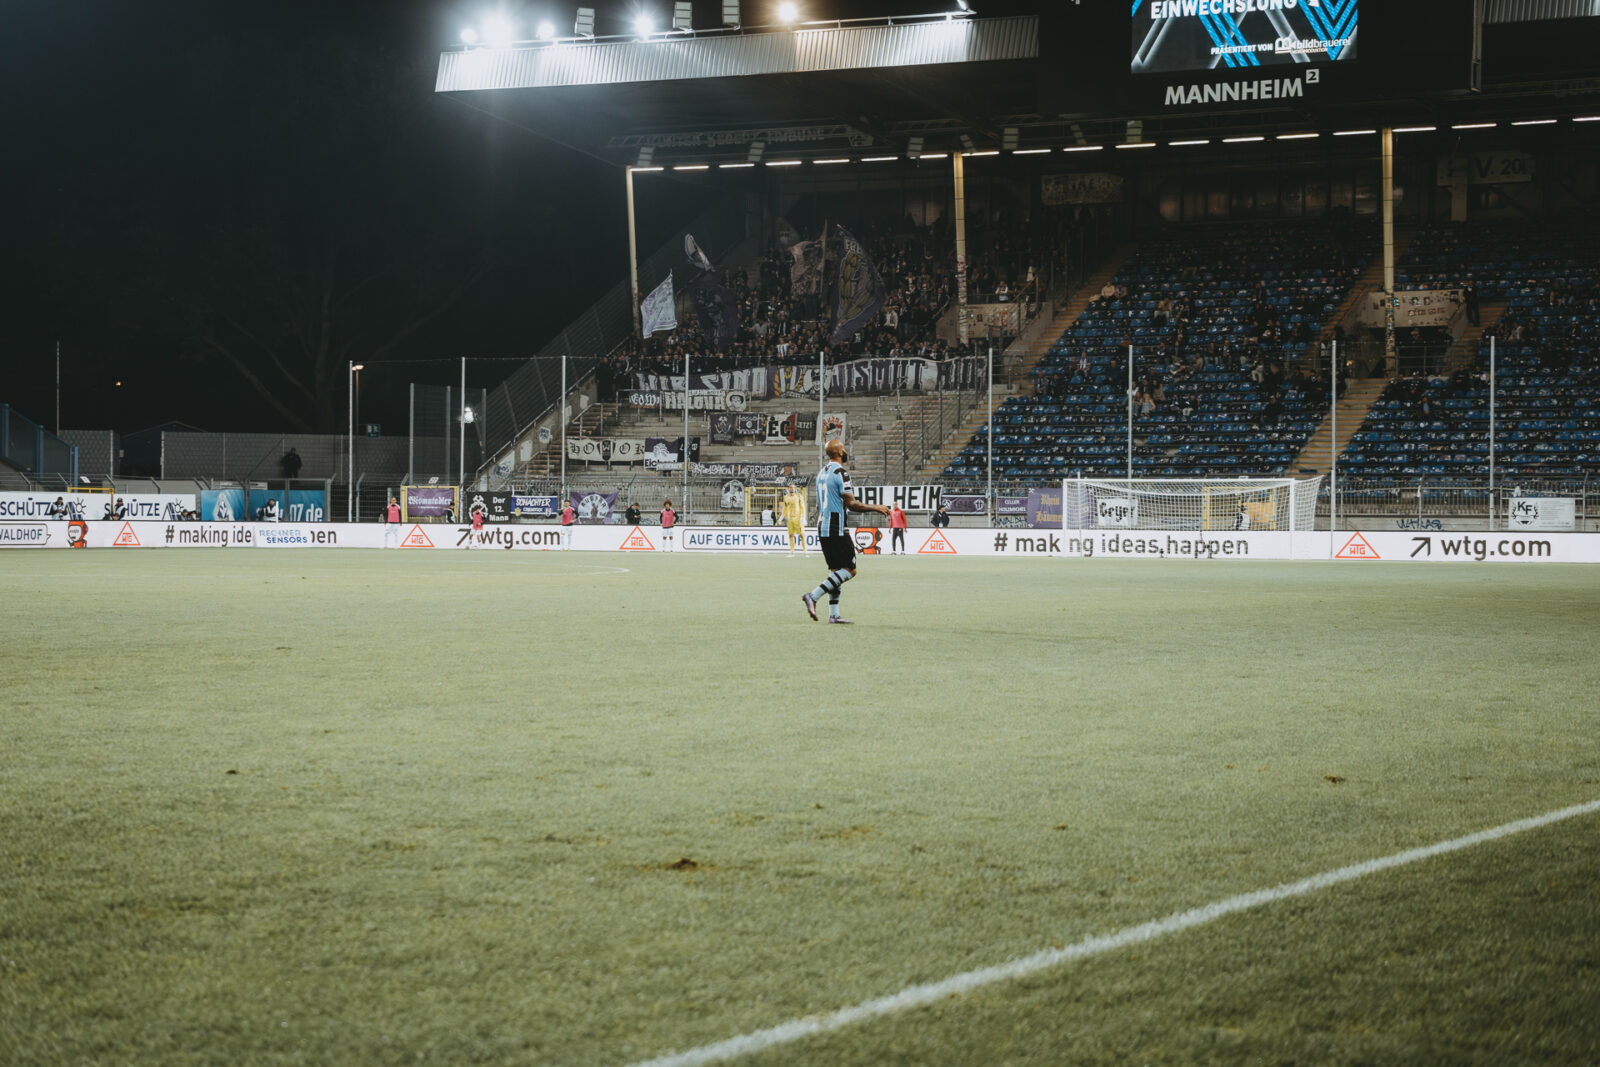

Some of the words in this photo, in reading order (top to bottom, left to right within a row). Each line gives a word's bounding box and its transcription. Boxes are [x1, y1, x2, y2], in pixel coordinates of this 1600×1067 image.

[1151, 0, 1298, 19] EINWECHSLUNG
[1257, 43, 1273, 52] VON
[1296, 37, 1351, 49] bildbrauerei
[1165, 77, 1303, 105] MANNHEIM
[0, 497, 52, 516] SCHÜTZ
[853, 486, 942, 510] HALHEIM
[104, 499, 160, 516] SHÜTZE
[179, 525, 228, 547] making
[411, 534, 424, 545] WTG
[480, 528, 560, 549] wtg.com
[631, 537, 644, 547] WTG
[689, 534, 713, 546] AUF
[716, 534, 759, 546] GEHT'S
[930, 540, 945, 551] WTG
[994, 533, 1008, 552] #
[1016, 533, 1093, 557] makng
[1101, 534, 1159, 553] ideas
[1167, 535, 1248, 559] happen
[1350, 544, 1366, 555] WTG
[1440, 536, 1552, 561] wtg.com
